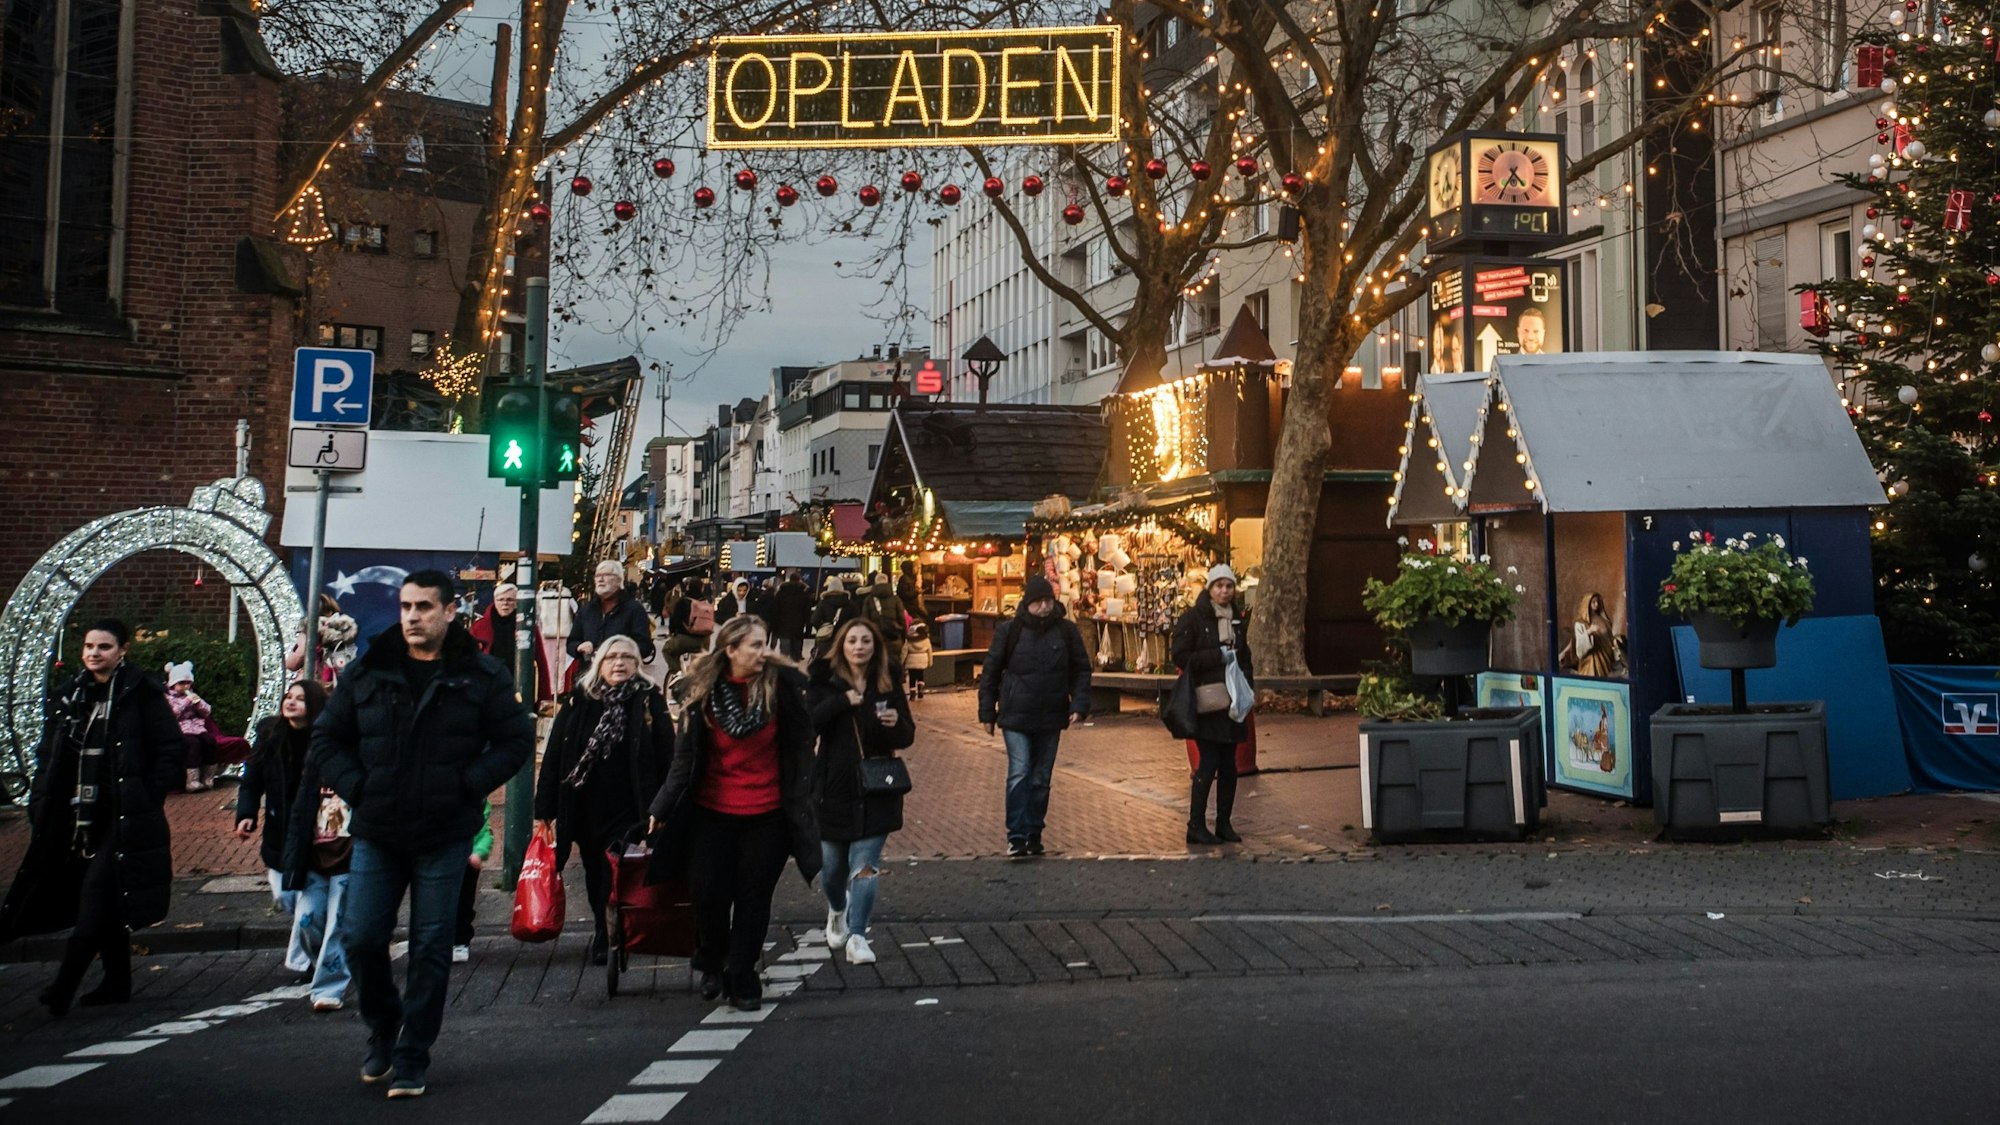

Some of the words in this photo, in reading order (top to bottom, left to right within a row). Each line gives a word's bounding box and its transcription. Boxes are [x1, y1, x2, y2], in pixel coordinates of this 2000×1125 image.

[724, 44, 1100, 130] OPLADEN
[312, 358, 354, 413] P
[1218, 519, 1226, 530] 8
[1643, 515, 1653, 530] 7
